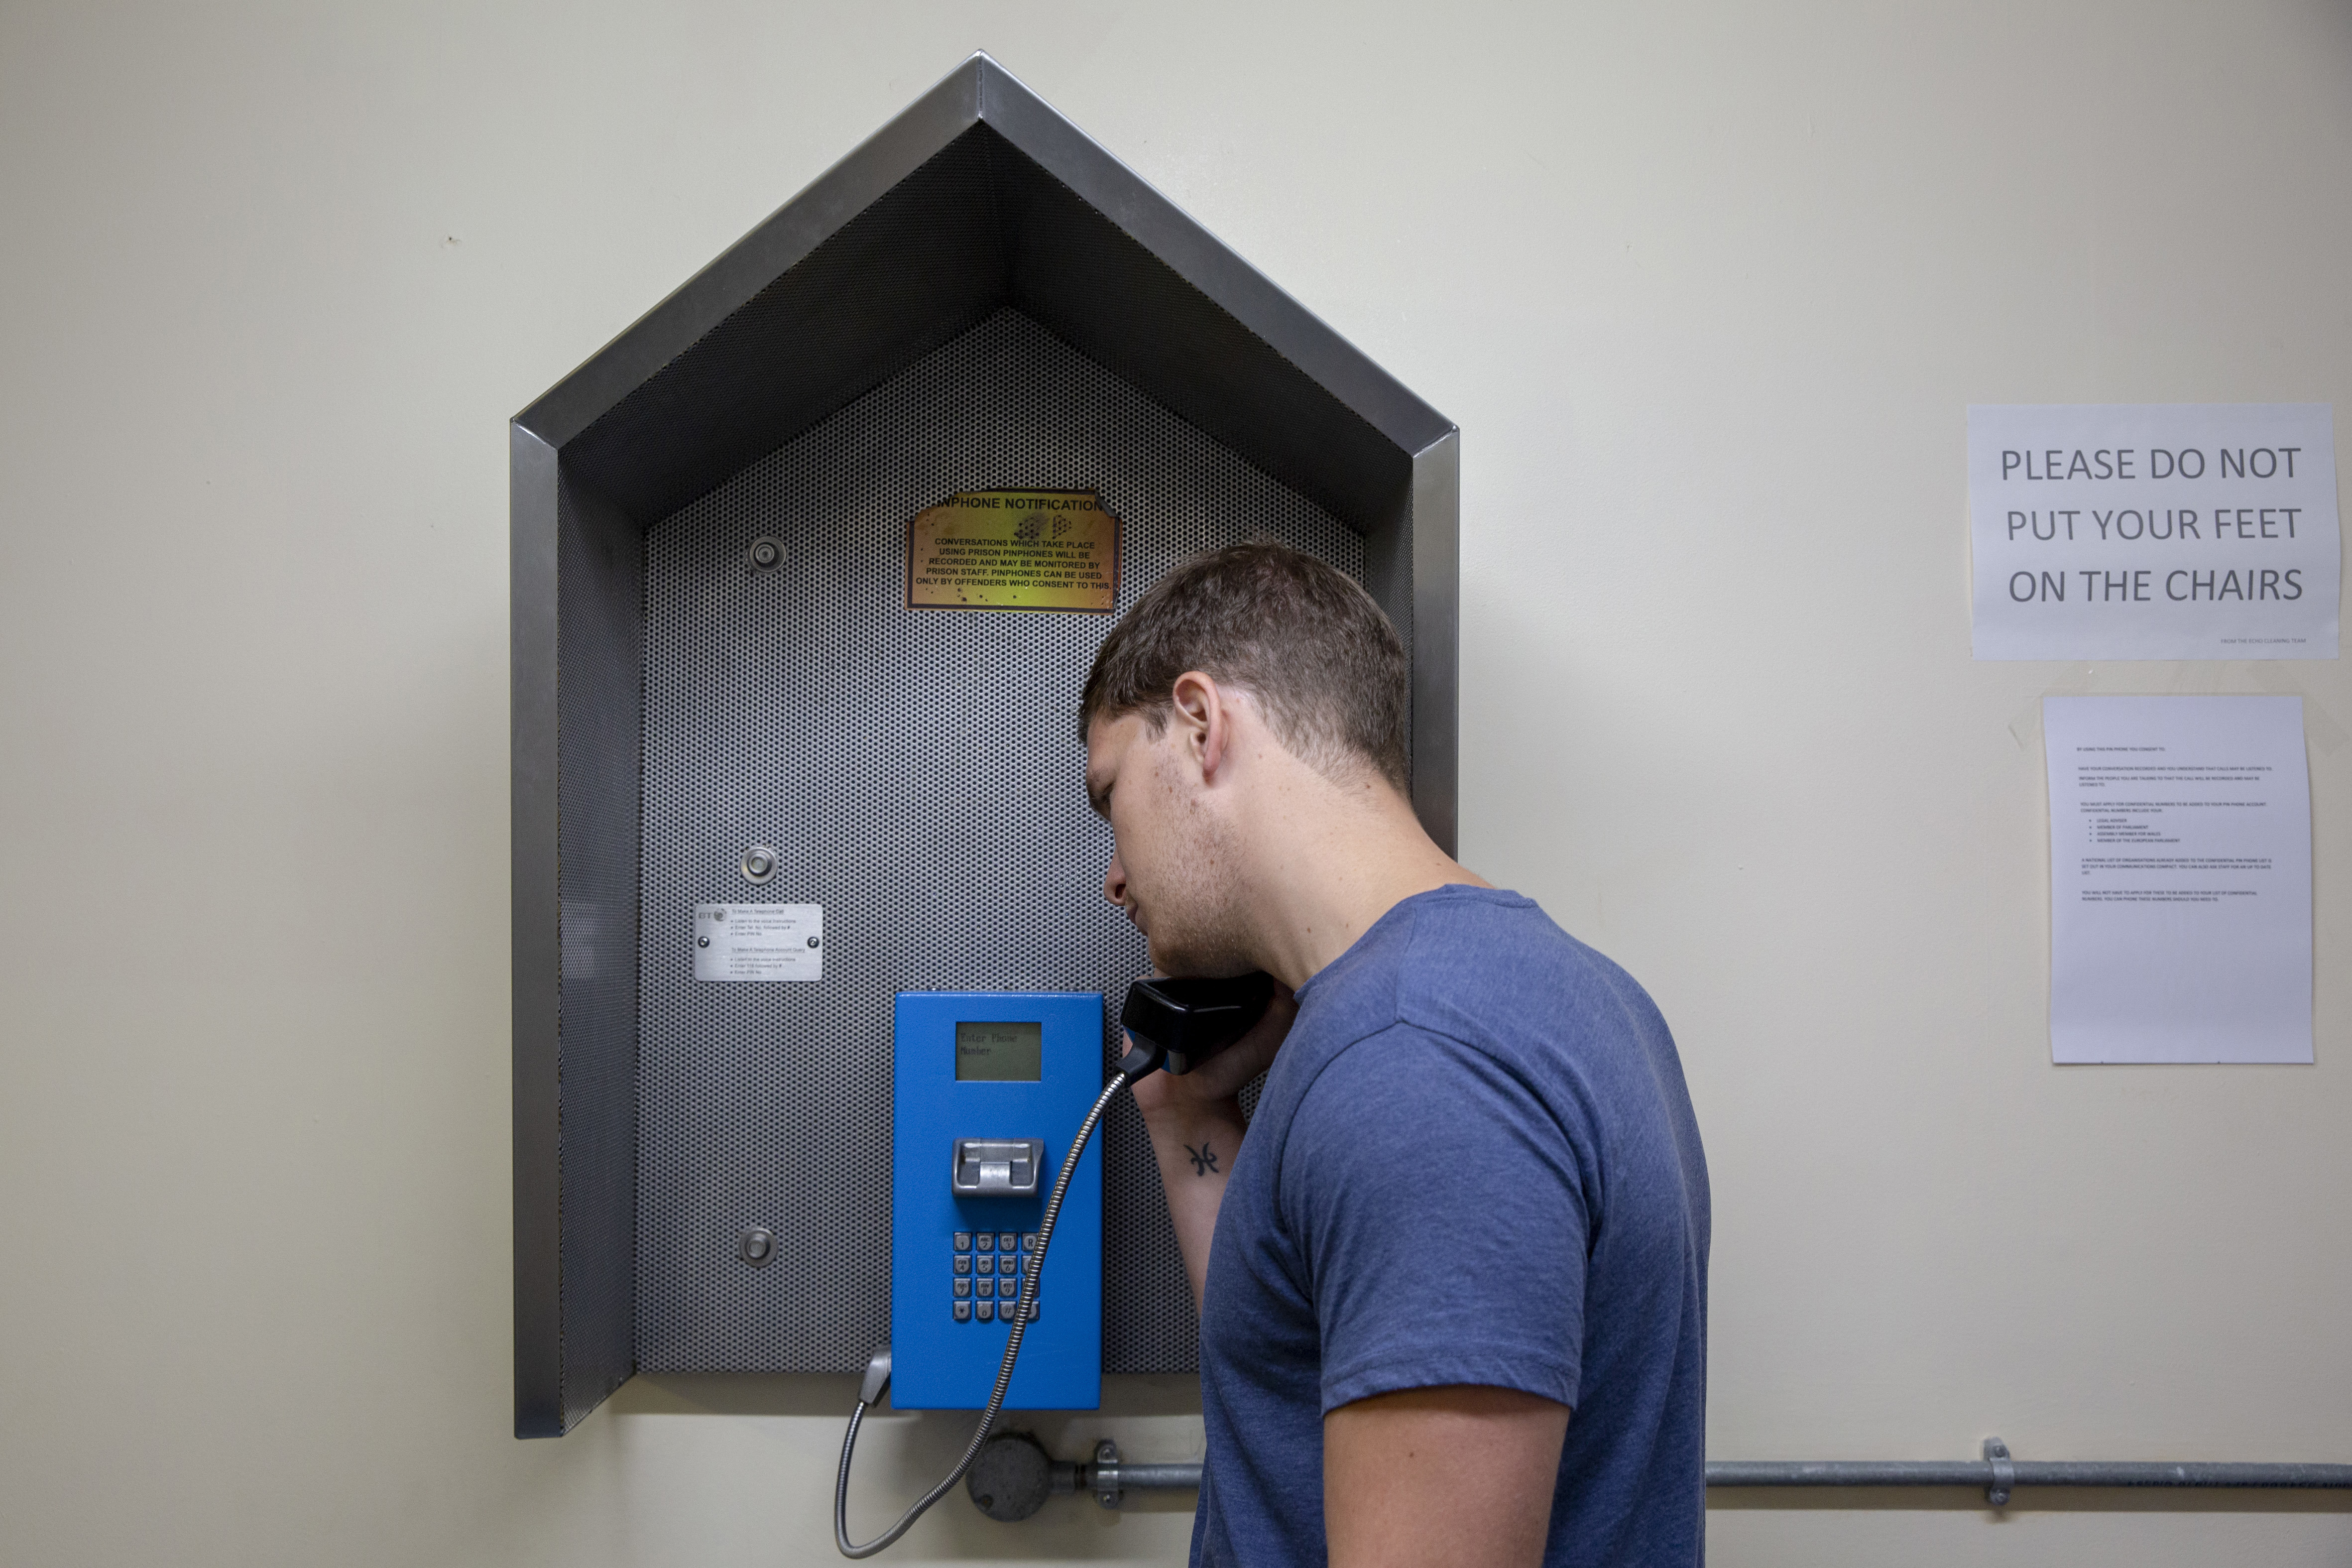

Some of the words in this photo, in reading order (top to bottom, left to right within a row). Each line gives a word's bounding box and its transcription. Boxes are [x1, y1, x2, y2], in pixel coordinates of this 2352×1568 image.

[2001, 449, 2135, 480] PLEASE
[2150, 449, 2205, 479] DO
[2220, 448, 2301, 478] NOT
[2007, 510, 2080, 540] PUT
[2093, 509, 2200, 540] YOUR
[2214, 509, 2300, 539] FEET
[935, 537, 1008, 546] CONVERSATIONS
[1010, 538, 1039, 547] WHICH
[2009, 571, 2065, 602] ON
[2080, 571, 2151, 601] THE
[2165, 569, 2302, 601] CHAIRS
[960, 1033, 986, 1042] Enter
[992, 1033, 1017, 1043] Phone
[960, 1047, 991, 1055] Number
